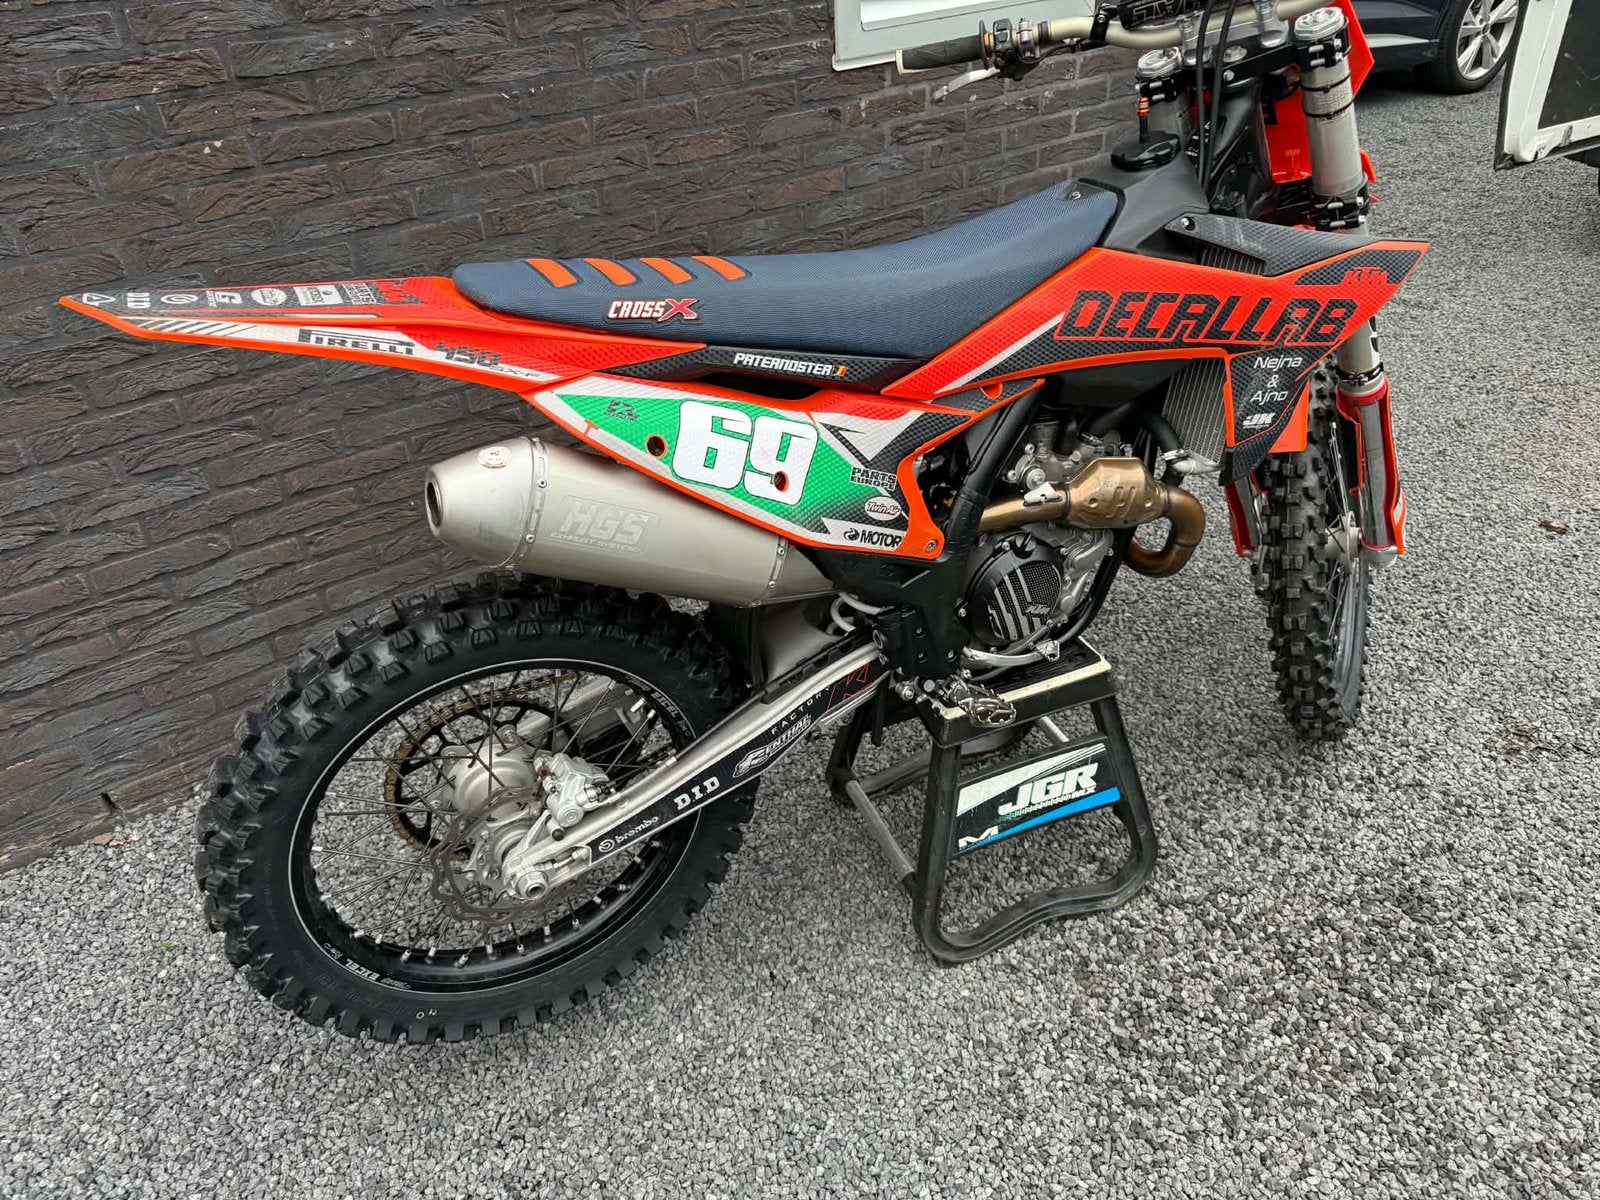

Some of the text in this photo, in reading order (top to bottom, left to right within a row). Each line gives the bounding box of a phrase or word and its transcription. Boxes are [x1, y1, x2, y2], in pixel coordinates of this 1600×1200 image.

[1342, 266, 1389, 286] KTM
[1054, 290, 1360, 347] DECALLAB
[298, 328, 416, 356] PIRELLI
[436, 341, 501, 367] 450
[733, 352, 833, 376] PATERNOSTER
[1253, 354, 1303, 372] Nejna
[1266, 374, 1280, 388] &
[670, 399, 820, 507] 69
[850, 475, 897, 491] EUROPE
[851, 466, 897, 484] PARTS
[866, 501, 900, 515] Twin Air
[559, 500, 651, 545] HGS
[860, 529, 903, 548] MOTOR
[998, 762, 1099, 816] JGR
[614, 815, 660, 844] brembo
[345, 958, 381, 982] EXCEL
